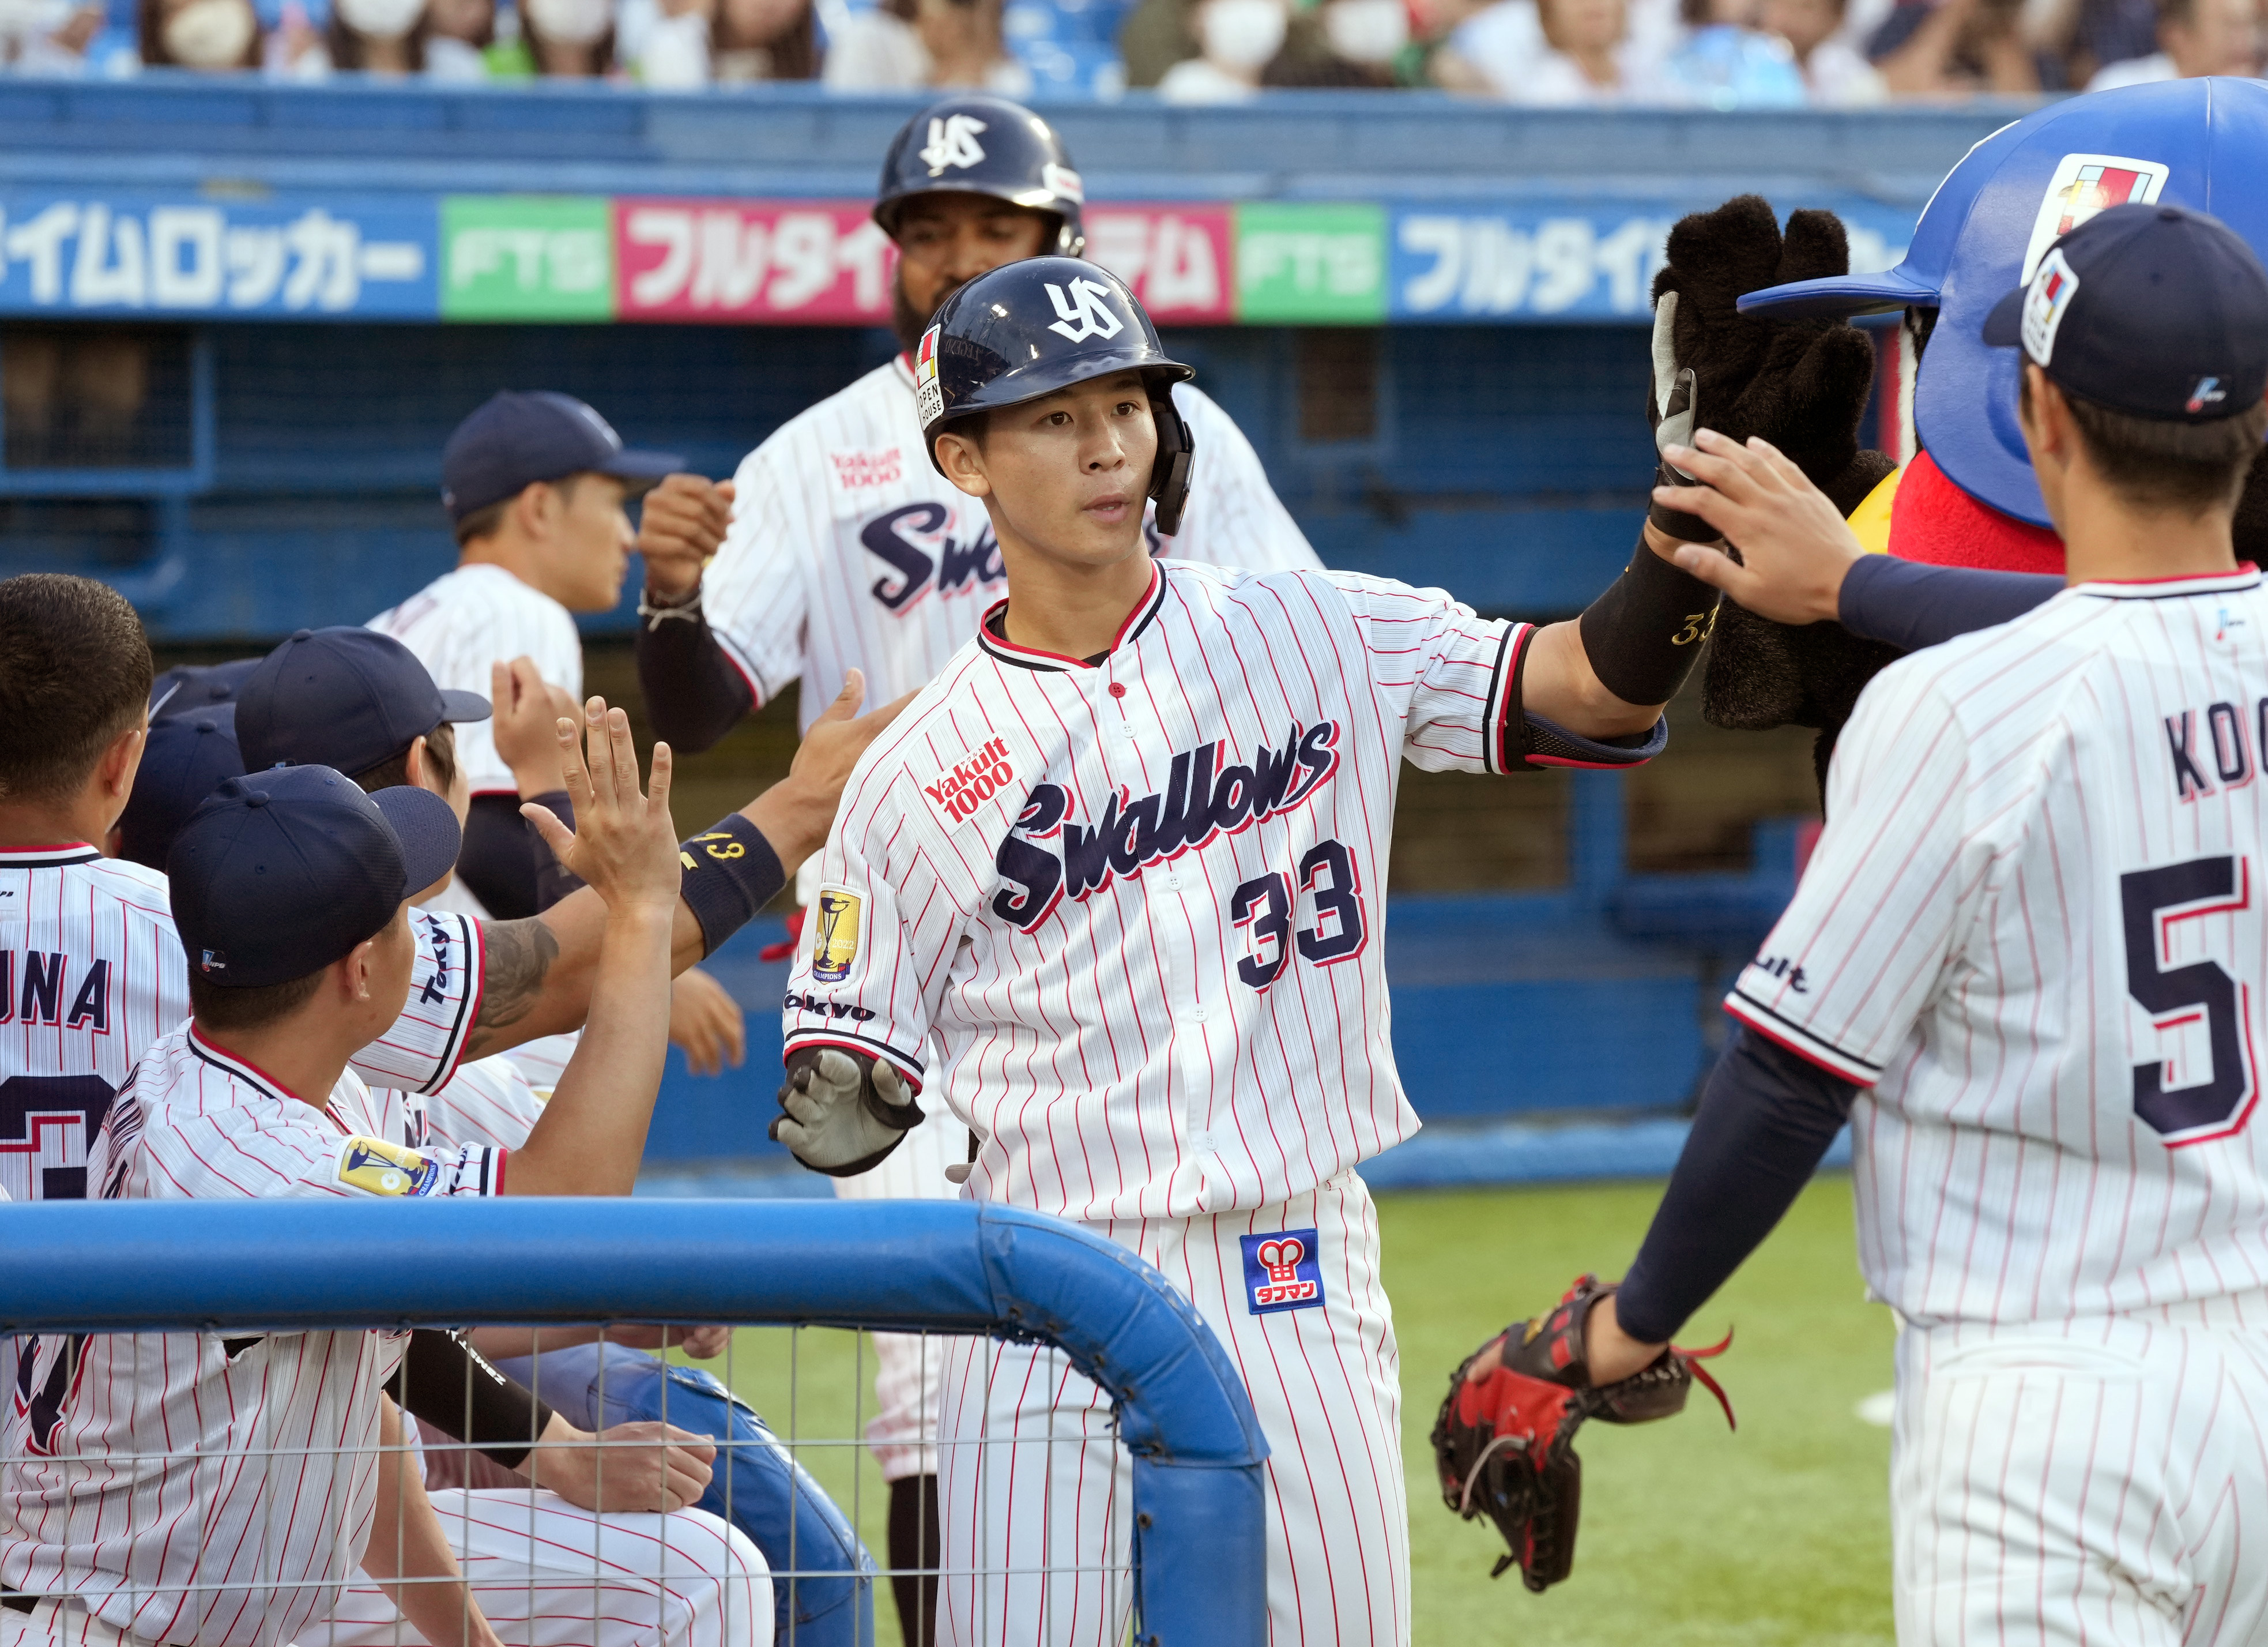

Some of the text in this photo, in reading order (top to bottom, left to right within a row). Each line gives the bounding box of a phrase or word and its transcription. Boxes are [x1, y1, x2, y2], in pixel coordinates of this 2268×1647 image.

[0, 202, 425, 313] イムロッカー
[627, 208, 899, 311] フルタイ
[918, 383, 939, 408] OPEN
[831, 448, 901, 468] Yakult
[841, 468, 901, 489] 1000
[2161, 698, 2268, 804] KO
[924, 736, 1010, 805] Yakult
[944, 761, 1013, 824] 1000
[992, 719, 1340, 935] Swallows
[1231, 838, 1369, 995] 33
[832, 938, 854, 950] 2022
[209, 961, 226, 969] NPB
[813, 970, 842, 980] CHAMPIONS
[784, 990, 876, 1021] okyo
[2119, 855, 2262, 1150] 5
[419, 1165, 436, 1196] CHAMPIONS
[1257, 1283, 1314, 1303] タフマン
